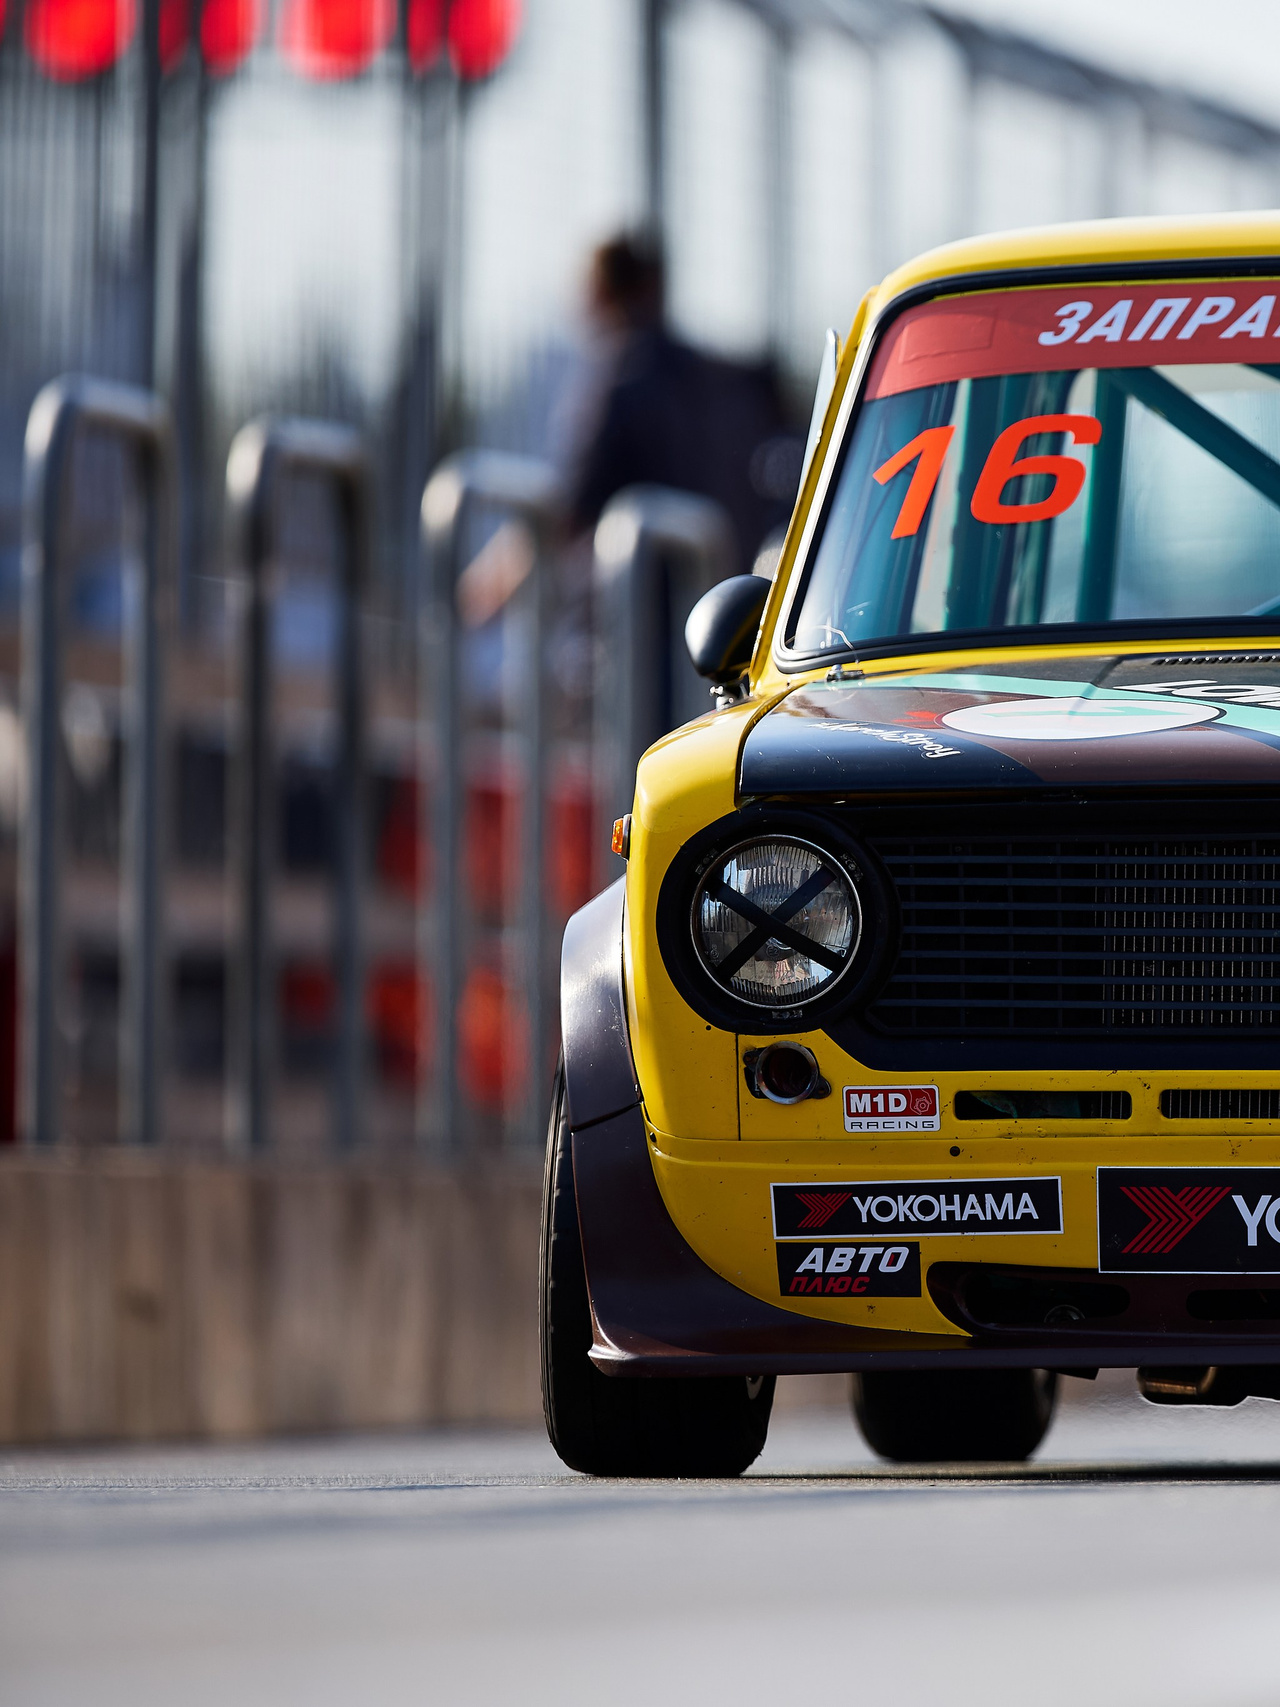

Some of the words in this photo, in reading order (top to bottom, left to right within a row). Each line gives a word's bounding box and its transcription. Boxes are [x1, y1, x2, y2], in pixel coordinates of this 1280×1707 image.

[871, 412, 1103, 541] 16
[850, 1091, 908, 1114] M1D
[850, 1120, 935, 1130] RACING
[852, 1192, 1040, 1223] YOKOHAMA
[795, 1246, 910, 1274] АВТО
[788, 1276, 871, 1293] ПЛЮС
